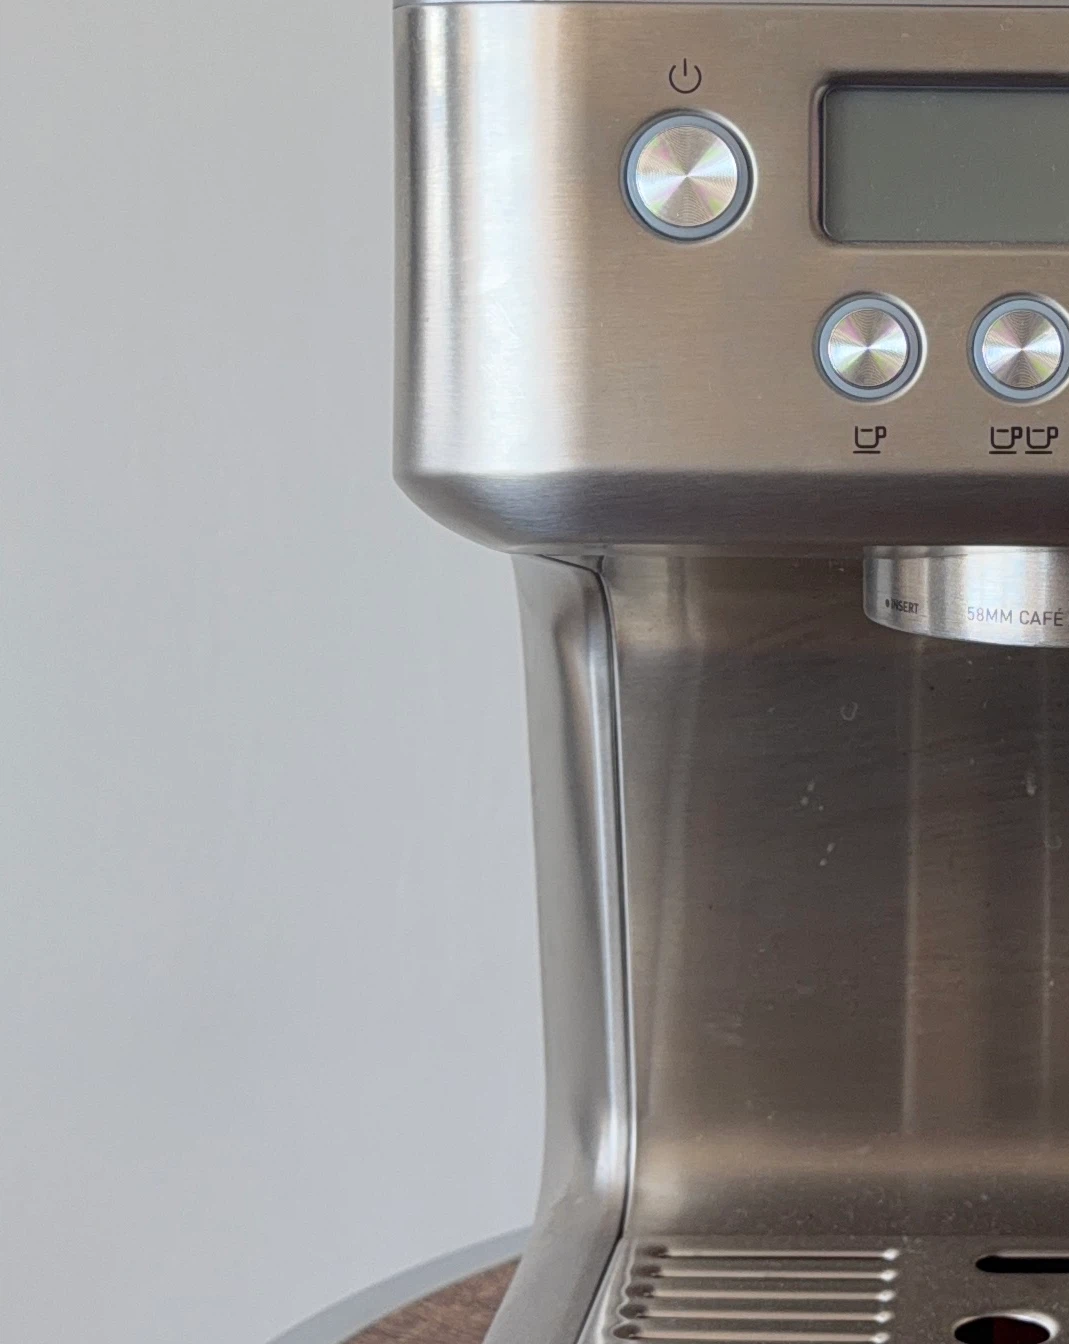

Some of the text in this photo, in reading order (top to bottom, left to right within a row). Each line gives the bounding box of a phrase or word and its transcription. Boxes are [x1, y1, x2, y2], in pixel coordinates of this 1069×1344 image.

[890, 598, 920, 615] INSERT
[967, 606, 1013, 624] 58MM
[1019, 608, 1064, 627] CAFÉ
